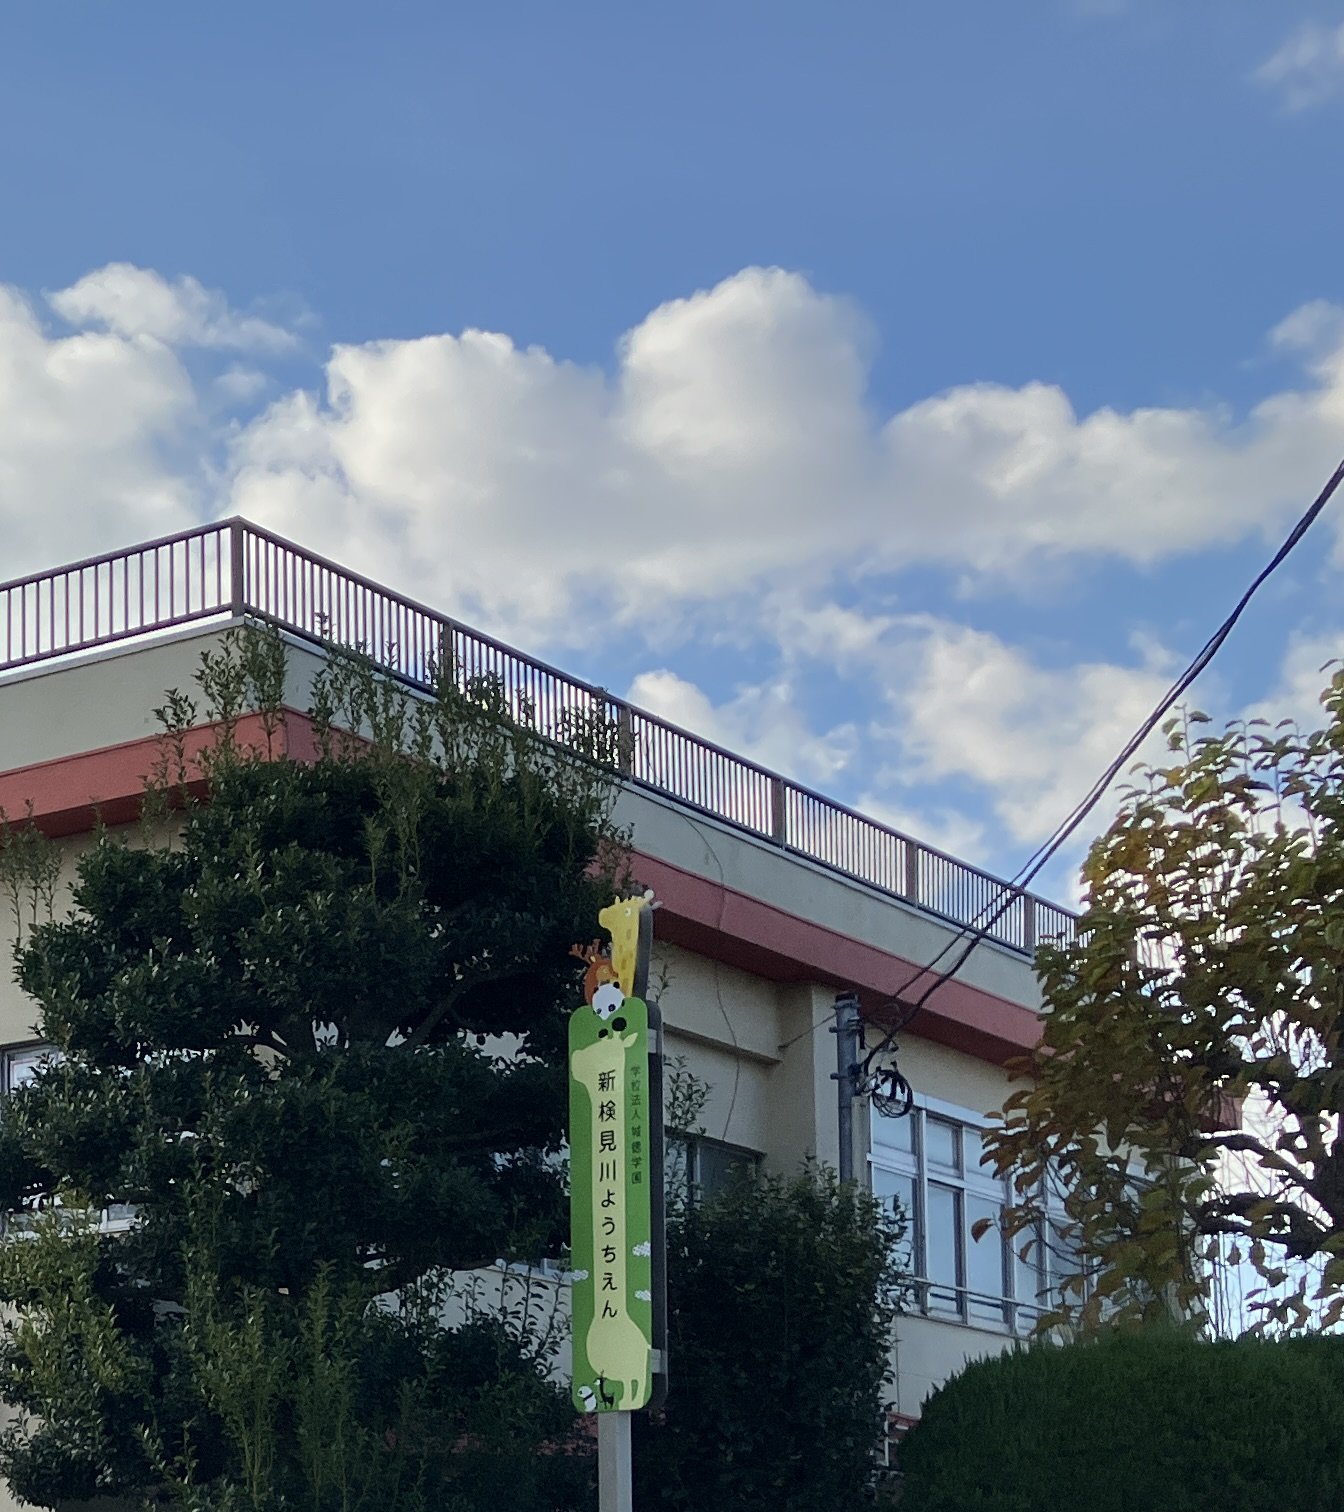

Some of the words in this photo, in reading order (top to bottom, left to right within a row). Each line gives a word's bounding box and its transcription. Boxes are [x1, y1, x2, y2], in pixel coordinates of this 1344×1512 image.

[597, 1068, 618, 1321] 新検見川ようちえん
